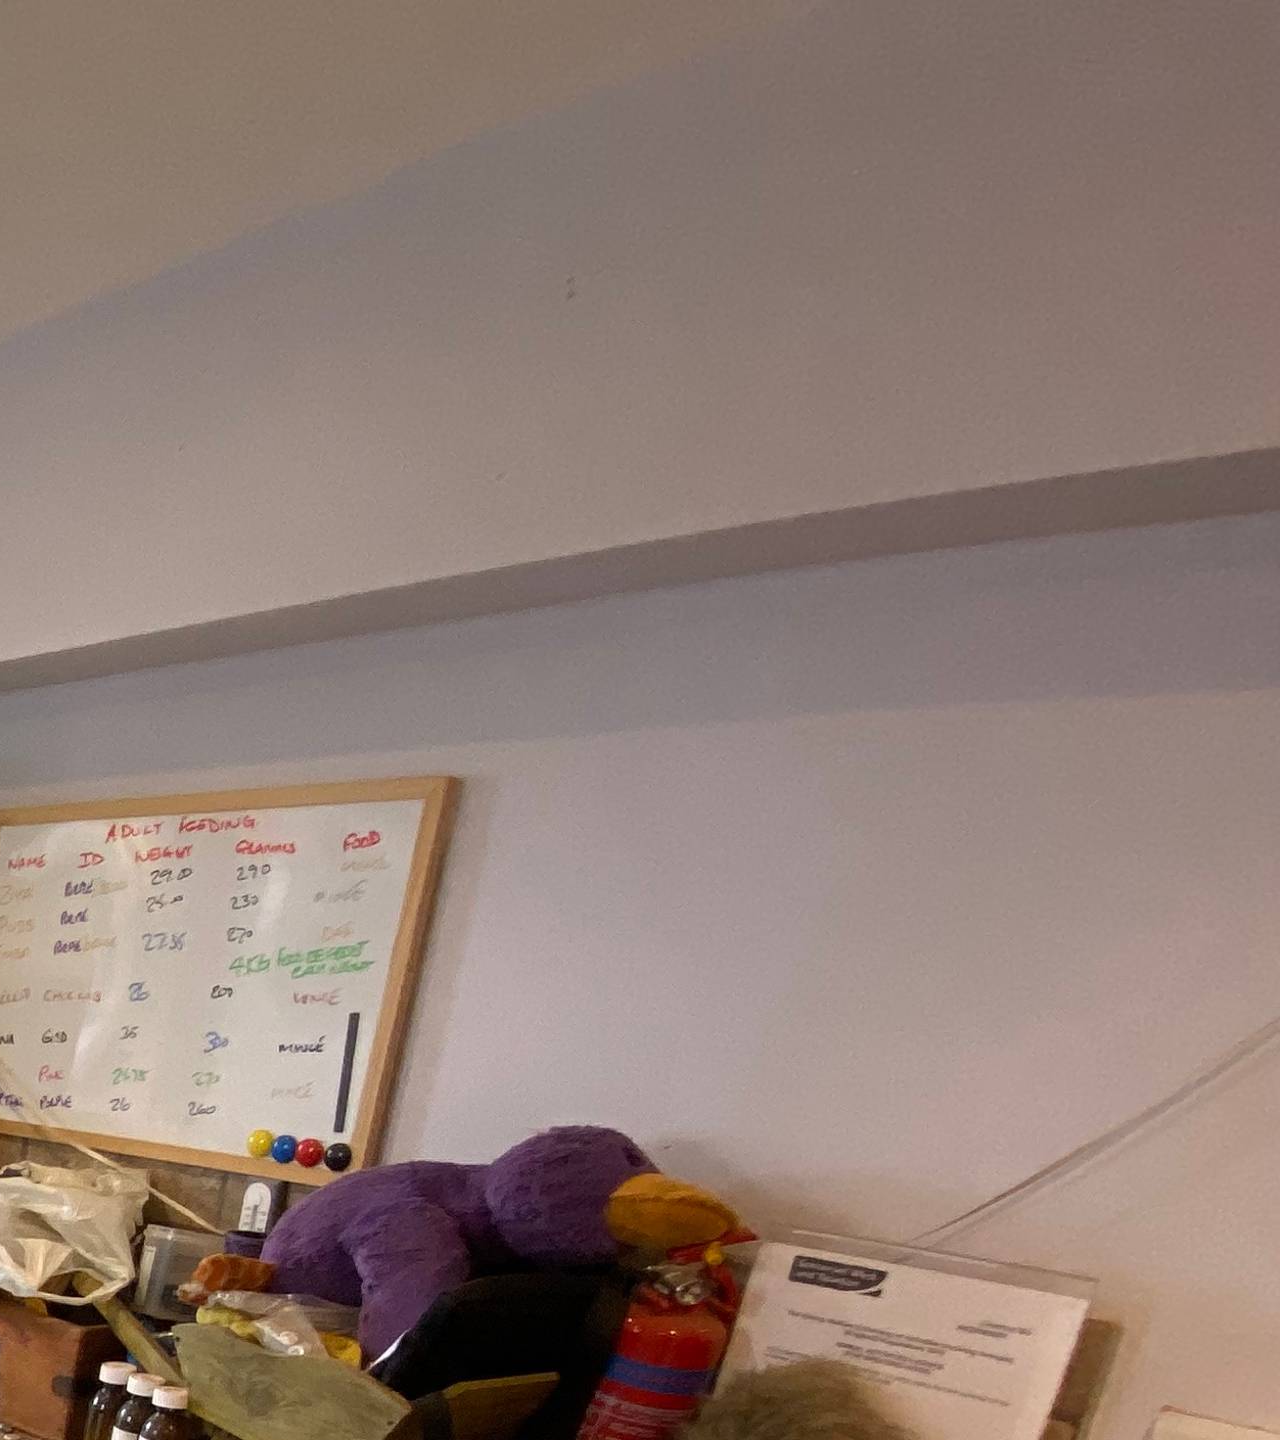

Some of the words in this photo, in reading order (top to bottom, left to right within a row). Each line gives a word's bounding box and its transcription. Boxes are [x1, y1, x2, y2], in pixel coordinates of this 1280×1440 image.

[105, 823, 162, 844] ADULT
[7, 854, 46, 871] NAME
[77, 852, 105, 868] ID
[342, 830, 381, 851] FOOD
